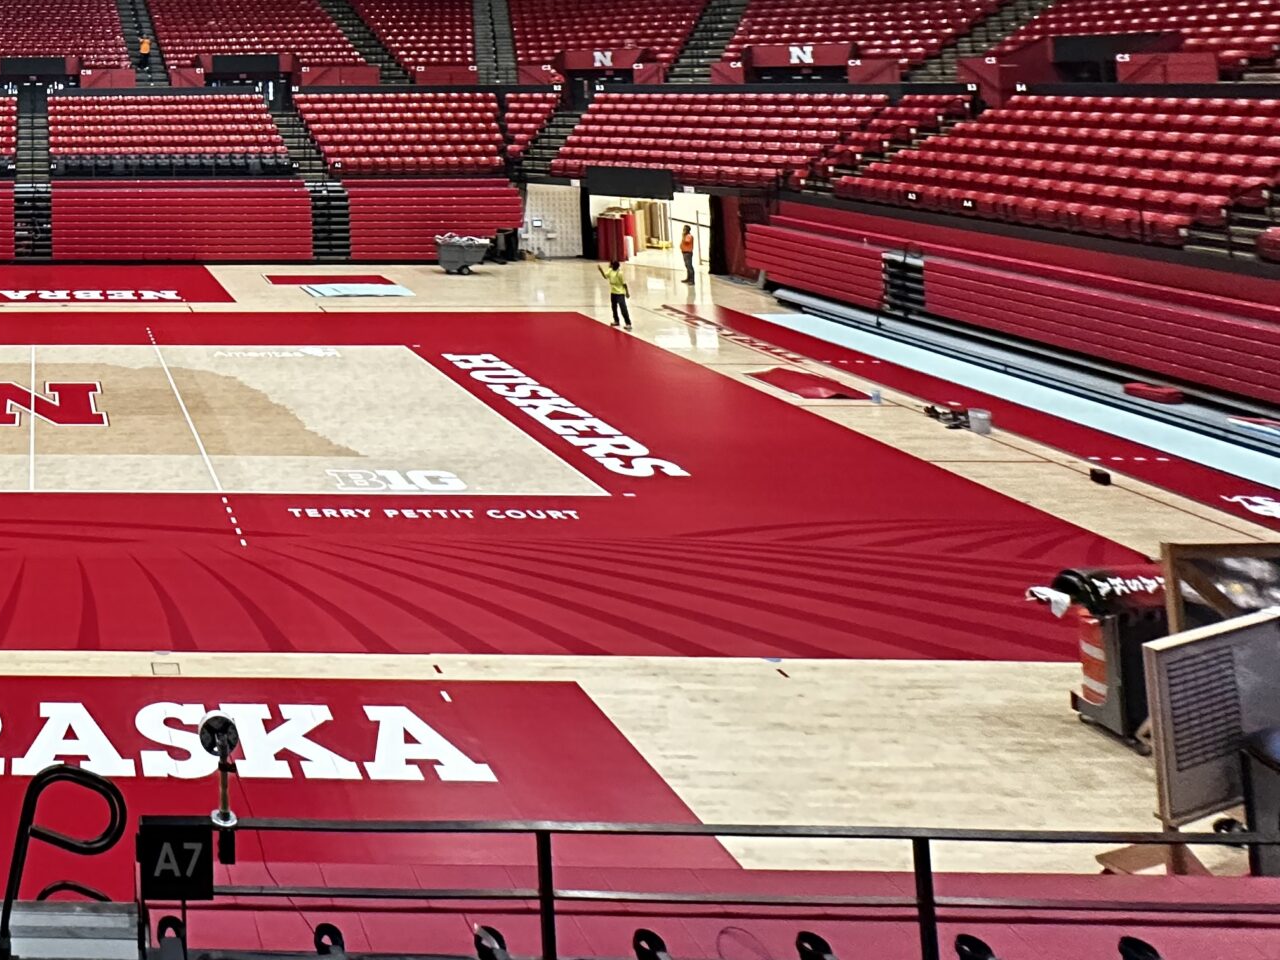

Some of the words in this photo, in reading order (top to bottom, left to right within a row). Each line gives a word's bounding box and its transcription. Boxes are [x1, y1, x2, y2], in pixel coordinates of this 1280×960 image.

[593, 51, 613, 67] N
[789, 46, 814, 64] N
[442, 352, 692, 479] HUSKERS
[287, 507, 371, 519] TERRY
[383, 508, 475, 520] PETTIT
[486, 509, 581, 521] COURT
[153, 842, 203, 878] A7
